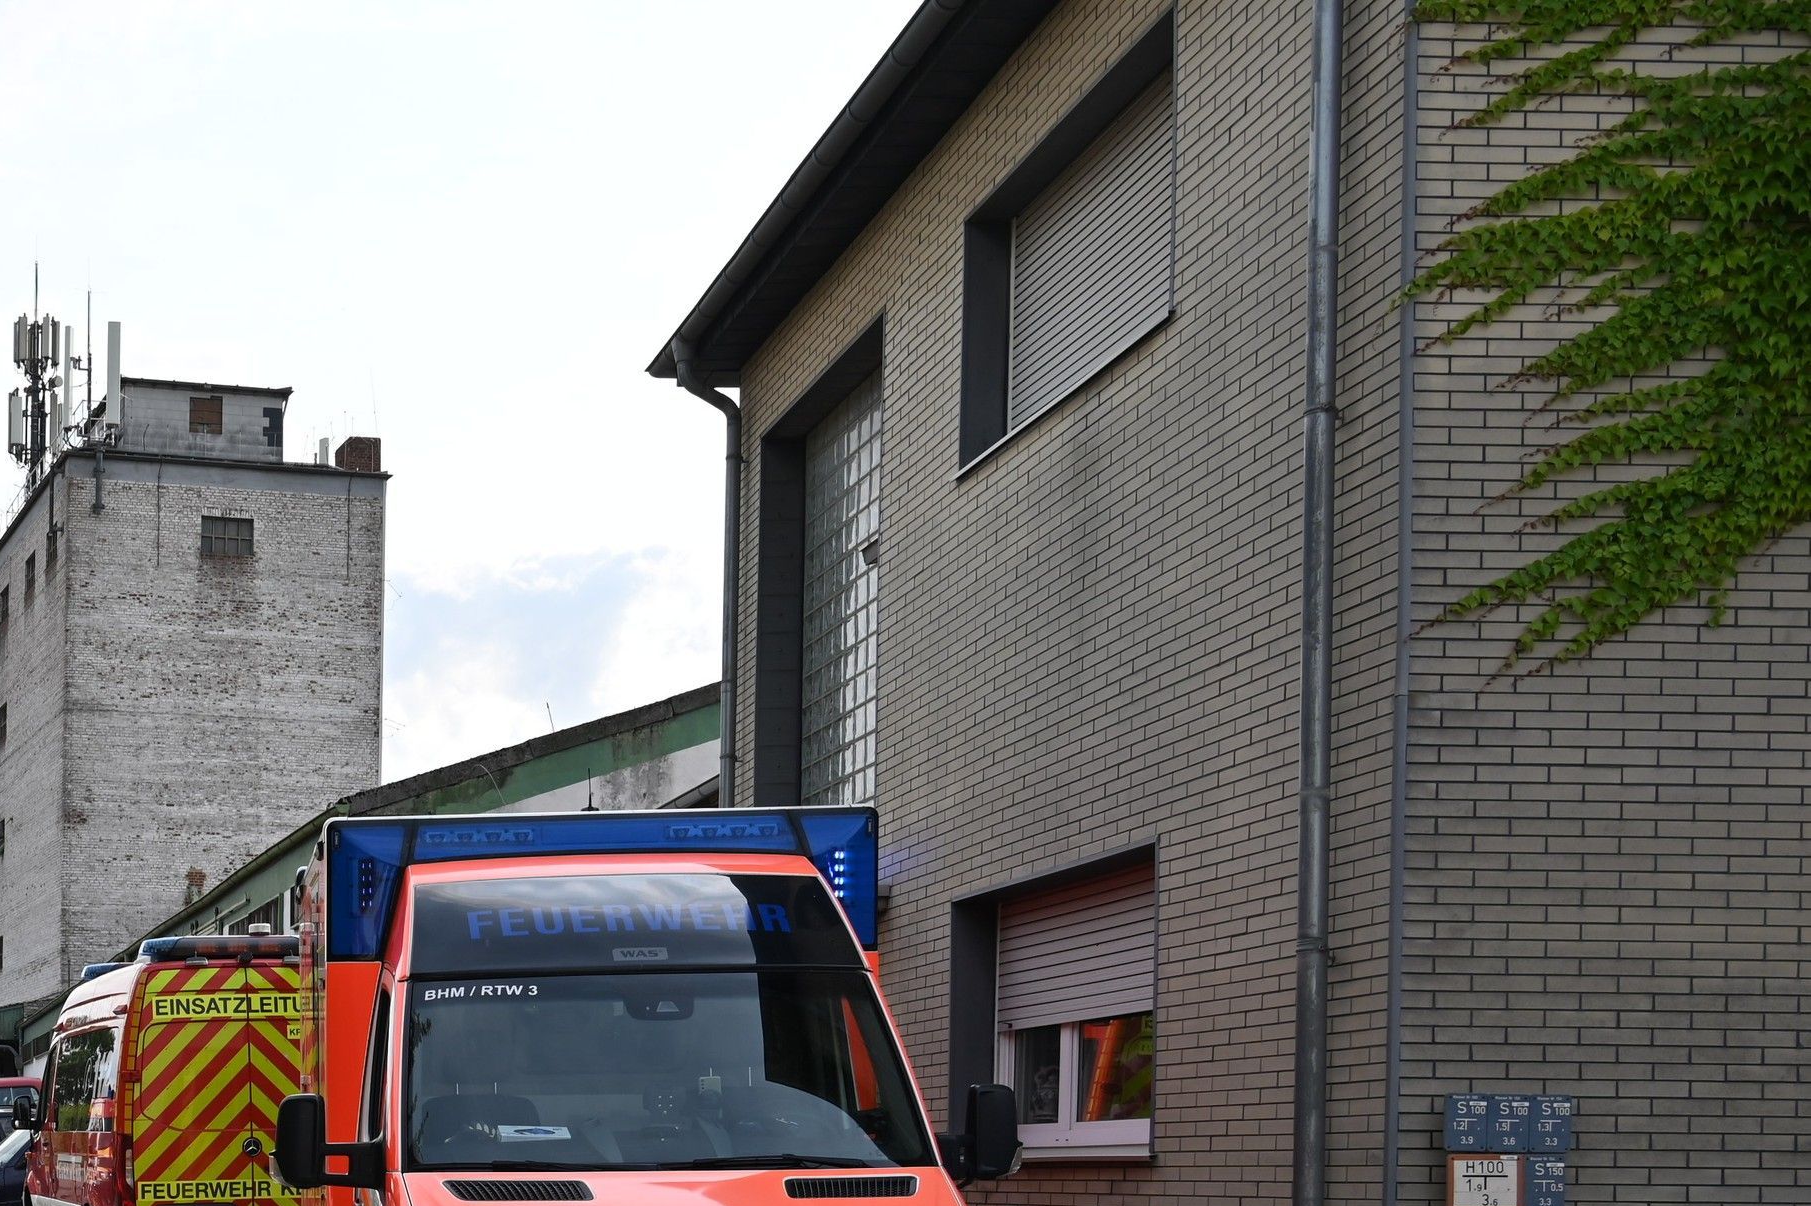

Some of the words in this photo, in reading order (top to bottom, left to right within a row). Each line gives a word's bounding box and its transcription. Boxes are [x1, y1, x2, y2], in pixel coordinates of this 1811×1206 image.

[465, 902, 794, 940] FEUERWEHR
[424, 985, 465, 1001] BHM
[469, 985, 477, 997] /
[480, 984, 524, 997] RTW
[527, 985, 539, 997] 3
[154, 995, 300, 1016] EINSATZLEITU
[1457, 1101, 1466, 1113] S
[1470, 1105, 1486, 1114] 100
[1499, 1102, 1509, 1114] S
[1512, 1106, 1528, 1115] 100
[1541, 1102, 1551, 1115] S
[1554, 1107, 1570, 1116] 100
[1534, 1162, 1544, 1175] S
[1548, 1167, 1564, 1176] 150
[140, 1180, 272, 1200] FEUERWEHR
